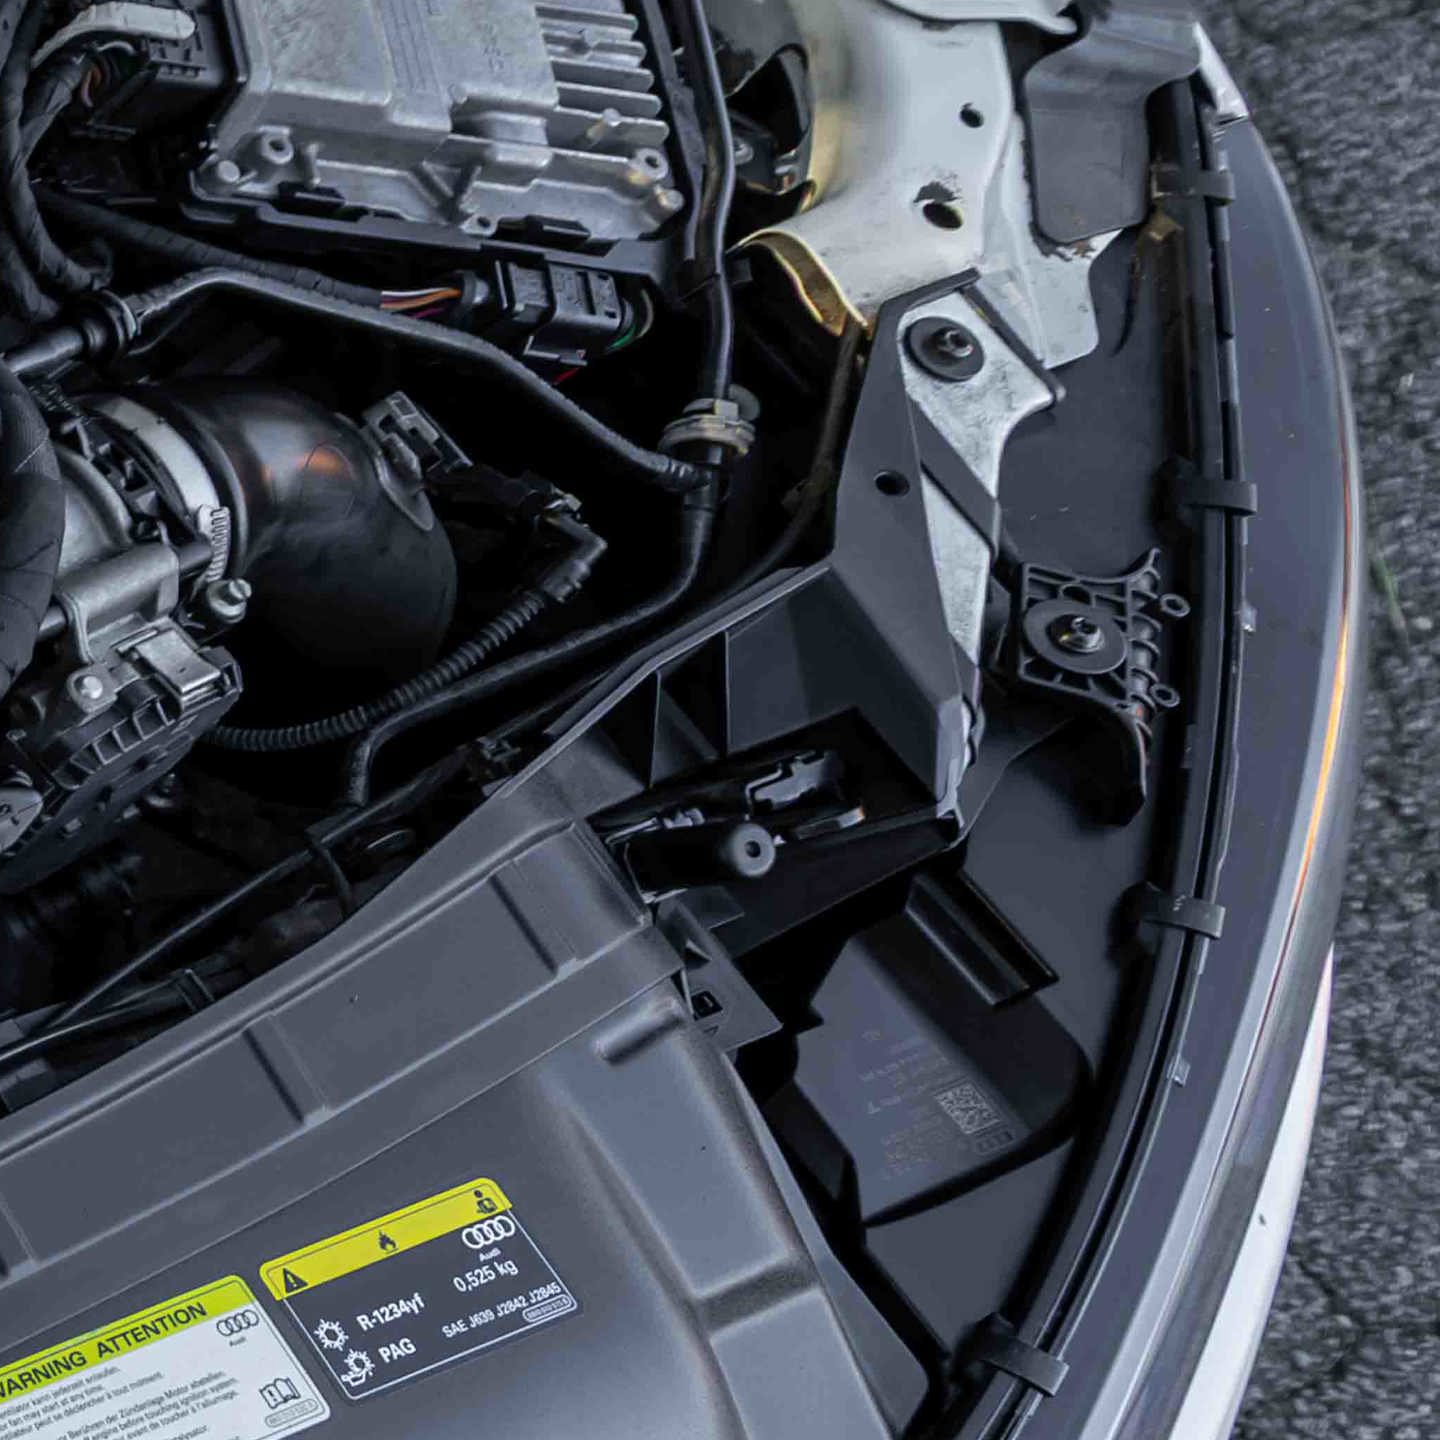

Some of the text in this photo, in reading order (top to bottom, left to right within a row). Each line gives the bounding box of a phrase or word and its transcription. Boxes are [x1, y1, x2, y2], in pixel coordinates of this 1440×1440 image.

[479, 1248, 501, 1261] Audi
[453, 1260, 518, 1291] 0,525 kg
[356, 1292, 424, 1331] R-1234yf
[442, 1319, 468, 1337] SAE
[469, 1309, 495, 1328] J639
[496, 1295, 528, 1317] J2842
[97, 1302, 207, 1358] ATTENTION
[378, 1338, 416, 1363] PAG
